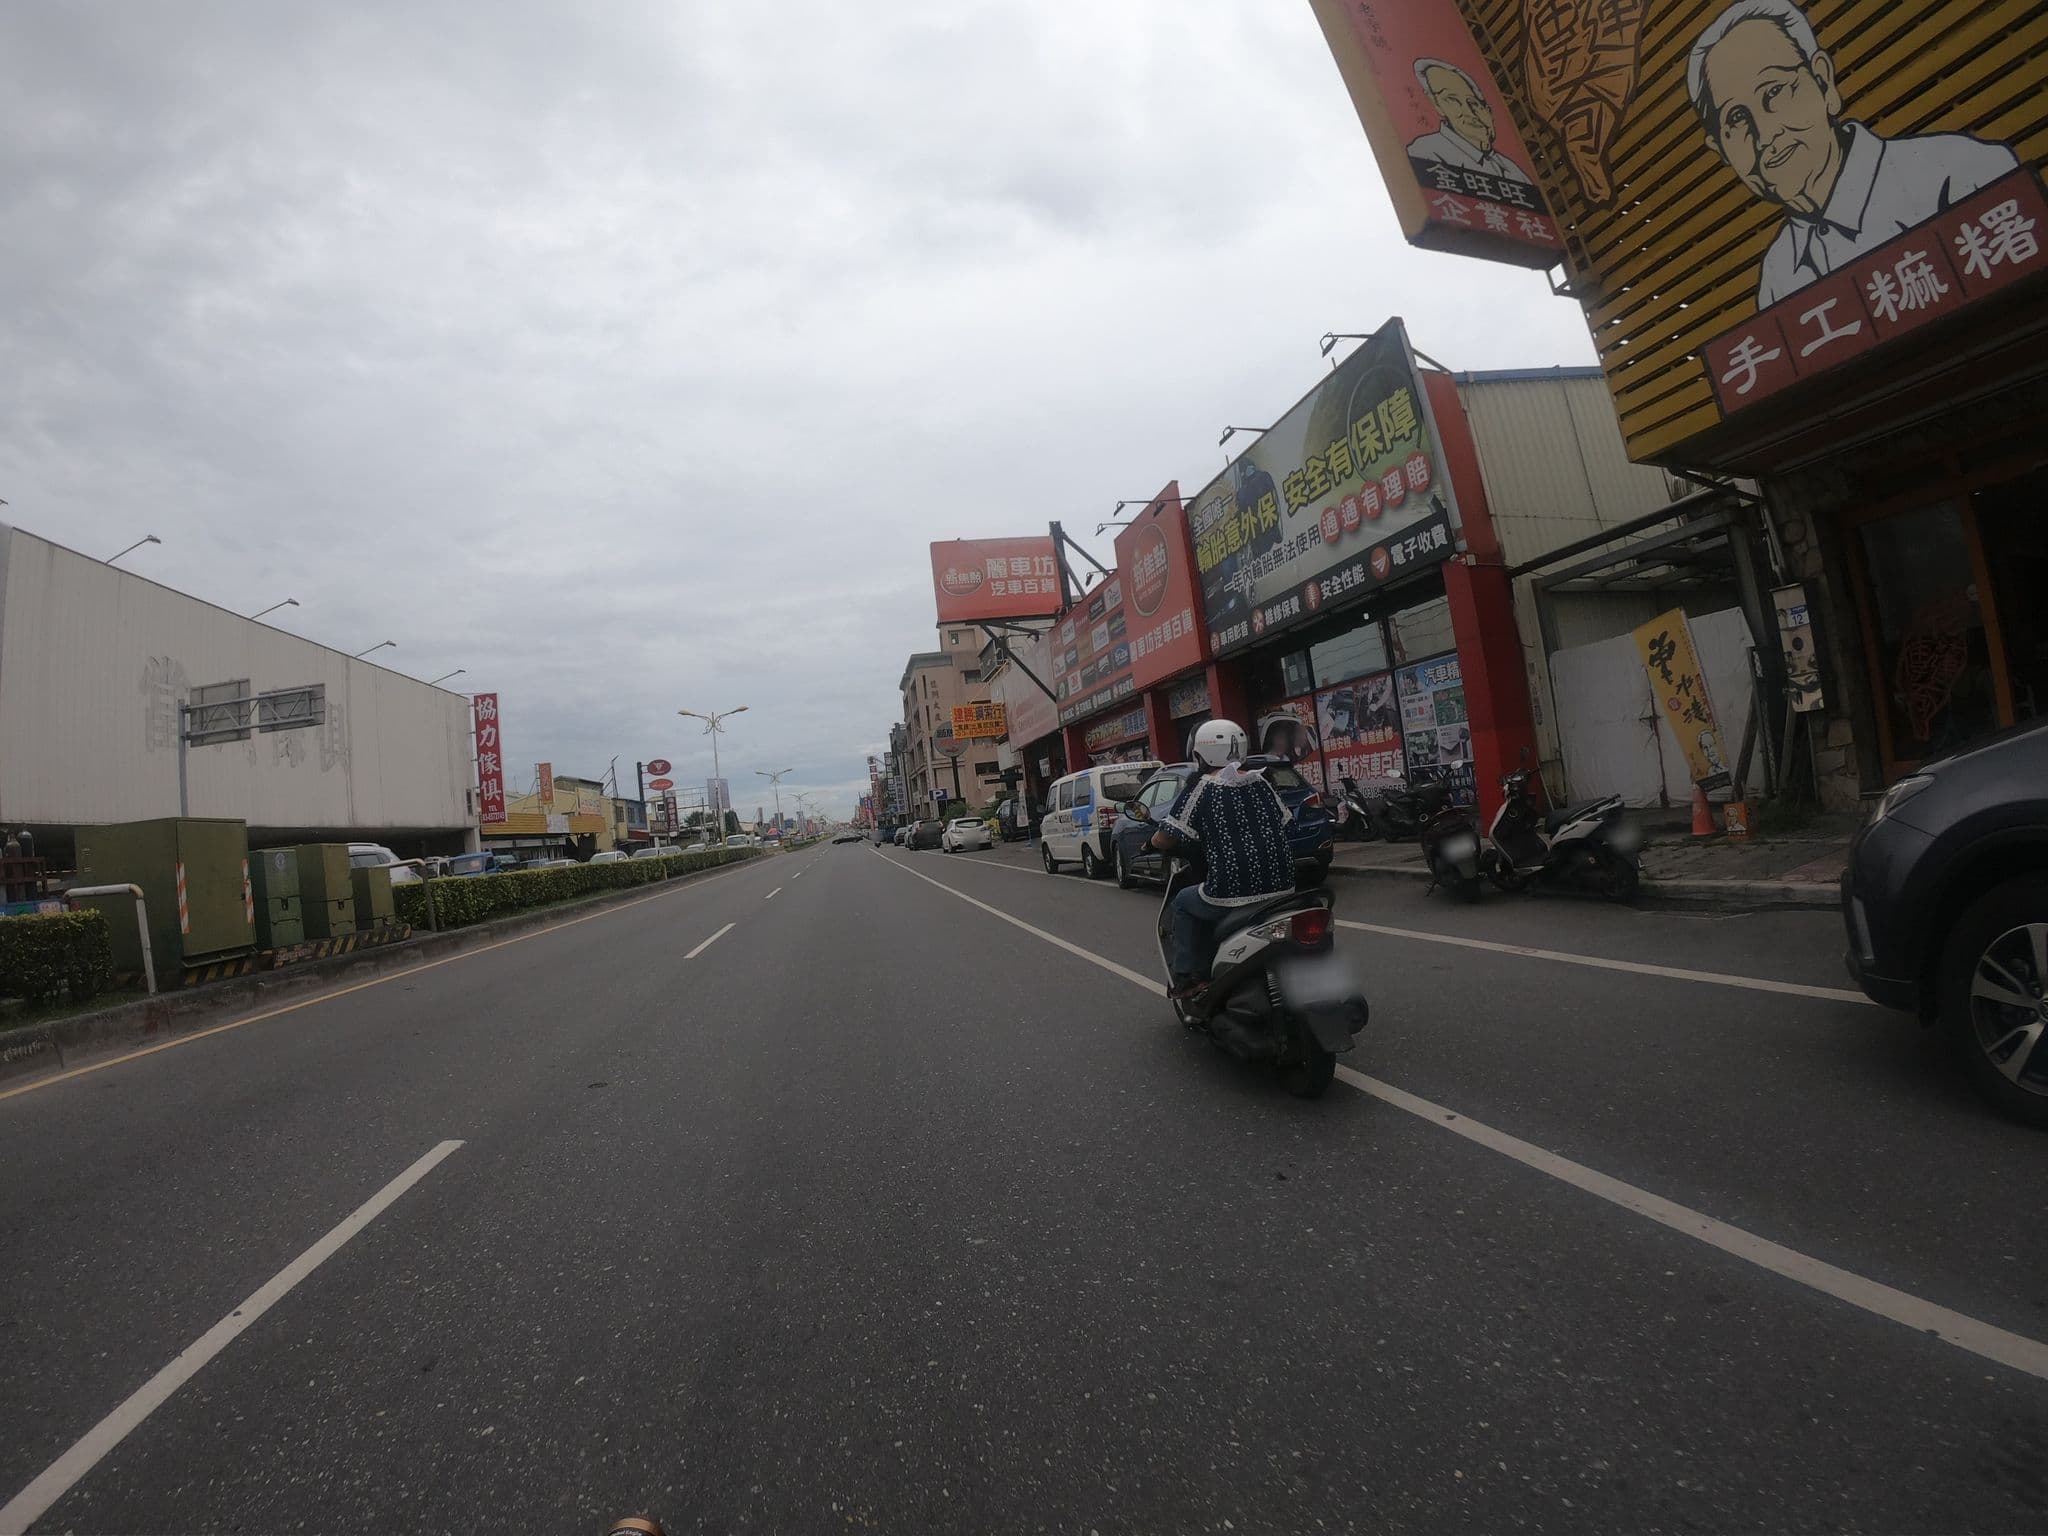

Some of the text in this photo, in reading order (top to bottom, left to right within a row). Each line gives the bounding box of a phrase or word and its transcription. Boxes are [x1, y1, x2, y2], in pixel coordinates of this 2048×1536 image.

[1425, 163, 1535, 208] 金旺旺
[1432, 194, 1554, 240] 企業社
[1283, 387, 1417, 517] 安全有保障
[1193, 493, 1233, 536] 全國唯一
[1322, 456, 1429, 537] 通通有理賠
[1196, 490, 1279, 573] 輪胎意外保
[1391, 523, 1448, 566] 電子收費
[985, 554, 1055, 579] 麗車坊
[1223, 523, 1322, 593] 一年內輪胎無法使用
[991, 578, 1056, 597] 汽車百貨
[1320, 563, 1365, 600] 安全性能
[1792, 614, 1804, 625] 12
[476, 696, 502, 801] 協力傢俱
[933, 790, 944, 799] P
